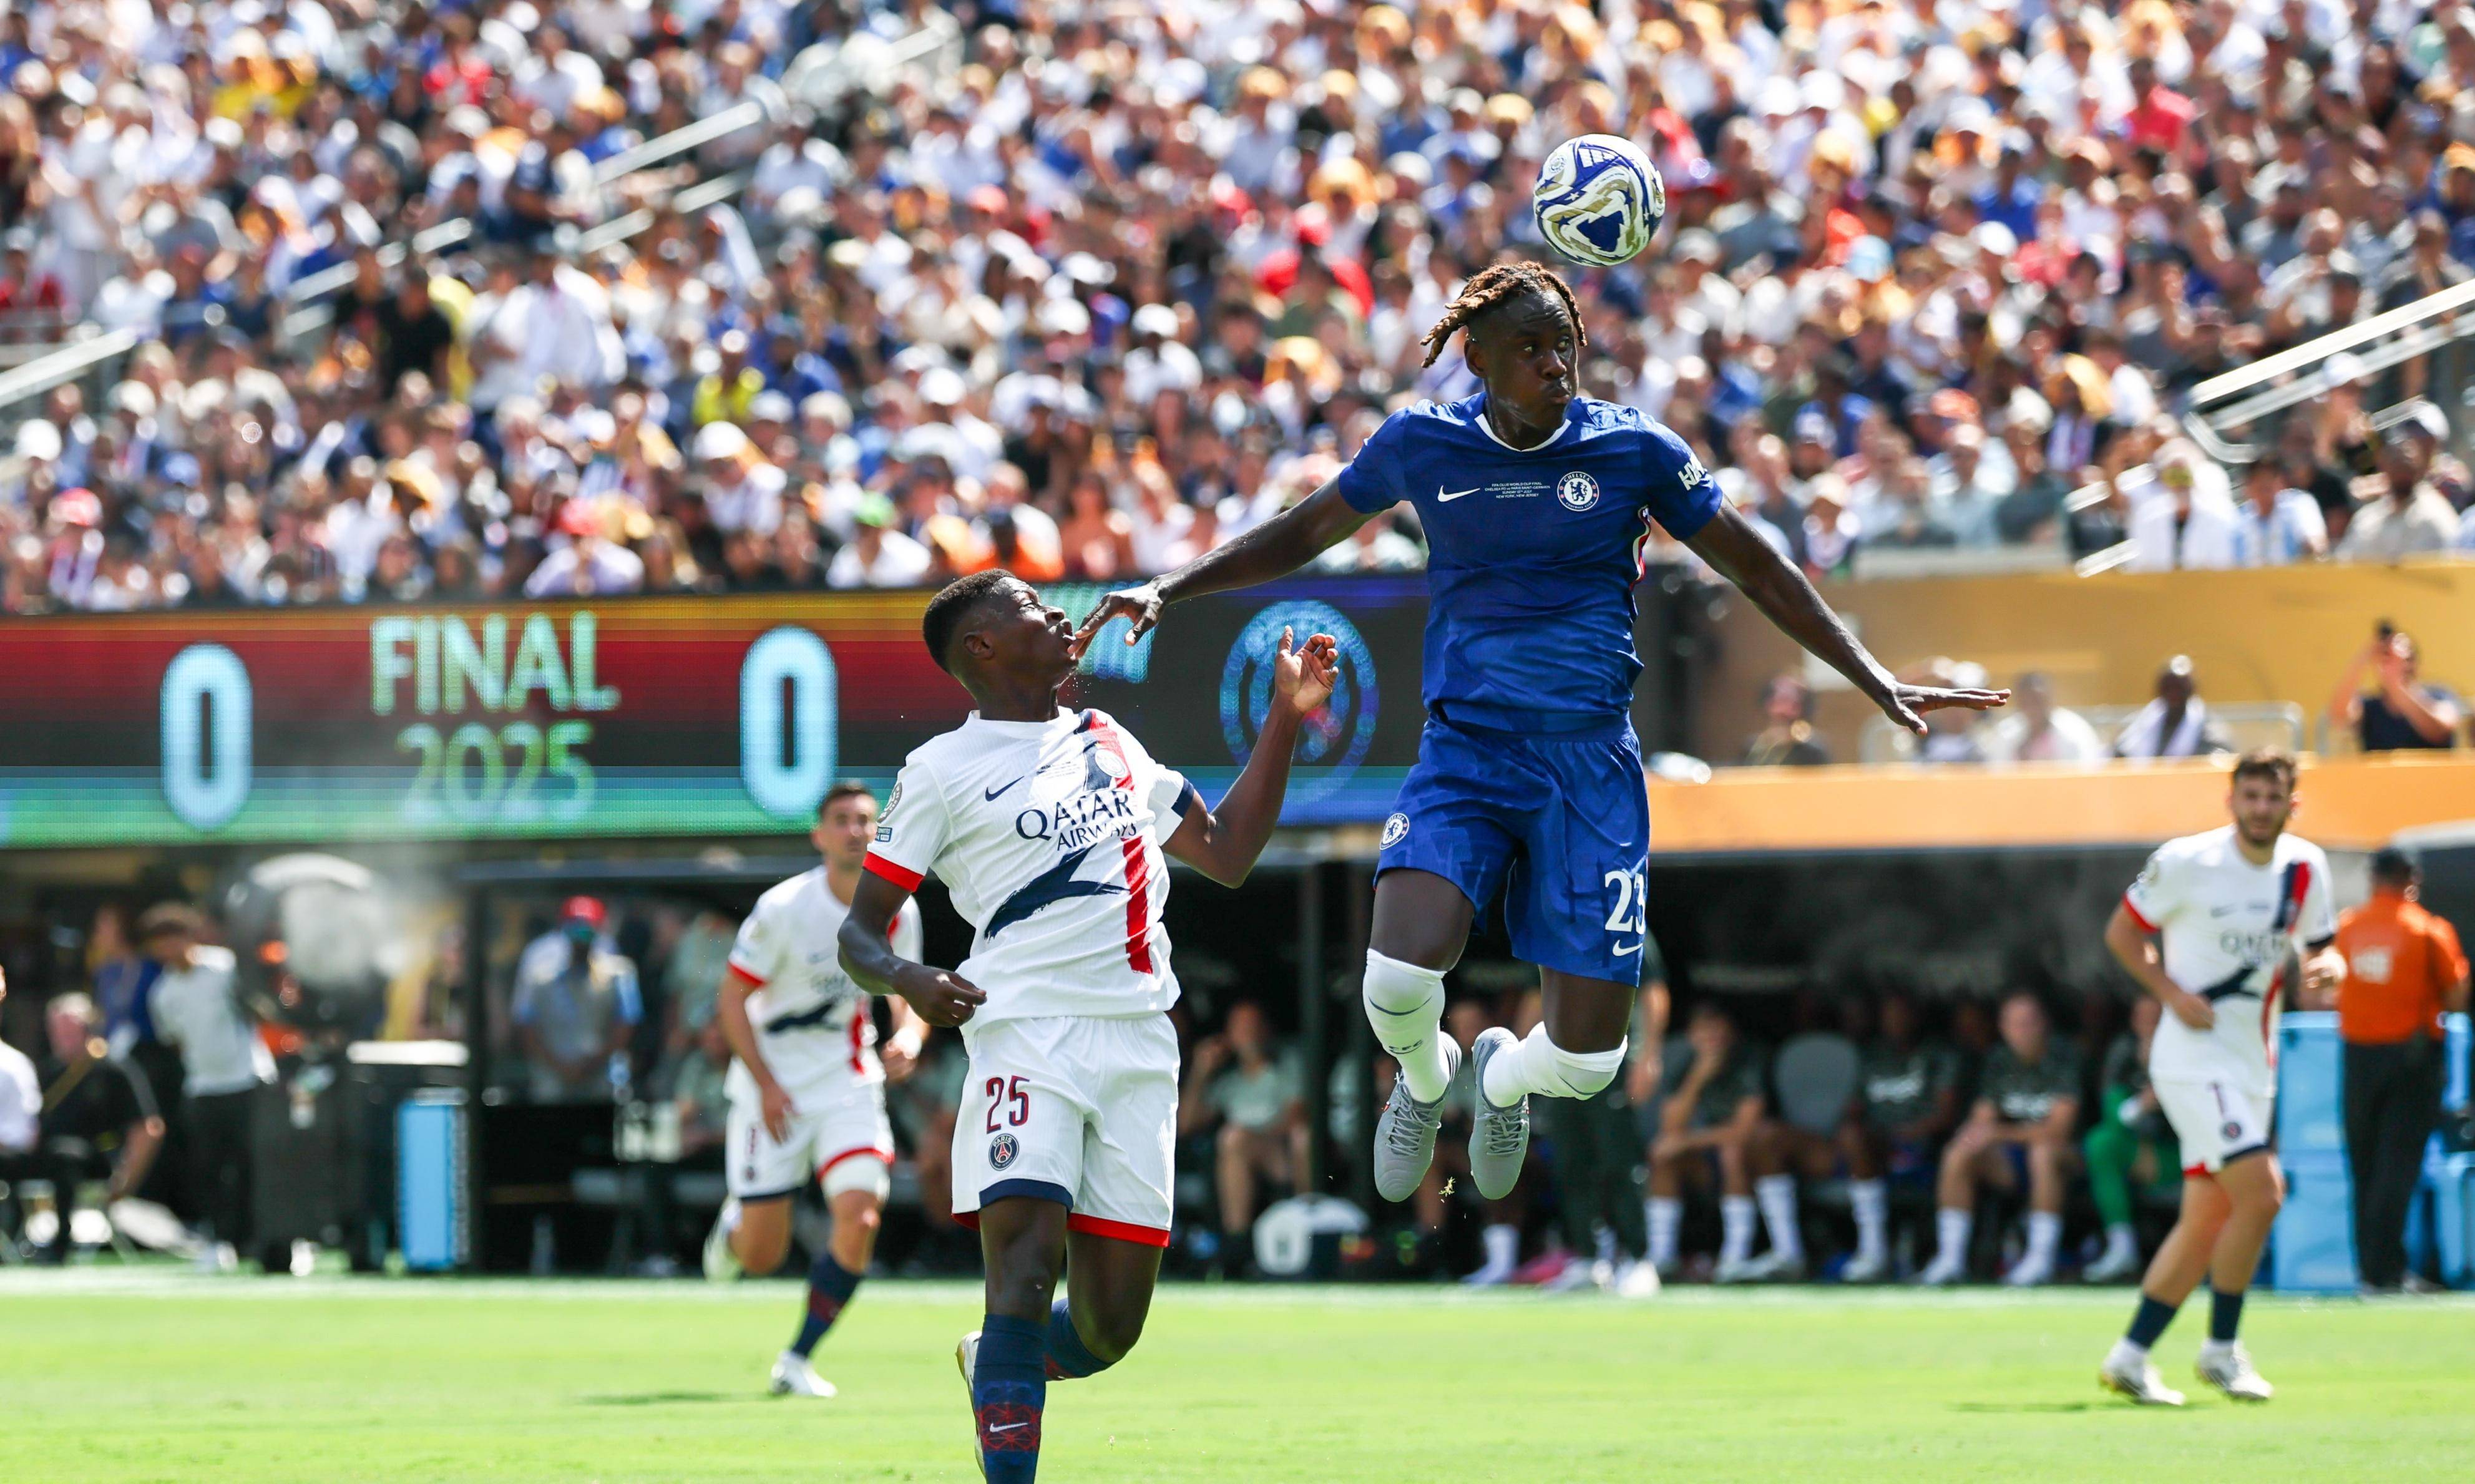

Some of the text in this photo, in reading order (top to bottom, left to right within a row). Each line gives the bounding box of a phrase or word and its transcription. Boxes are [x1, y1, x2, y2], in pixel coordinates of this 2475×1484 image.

[1564, 473, 1590, 482] CHELSEA
[371, 610, 622, 716] FINAL
[160, 641, 254, 831] 0
[740, 624, 839, 819] 0
[397, 720, 595, 825] 2025
[1015, 790, 1134, 841] QATAR
[1057, 823, 1136, 851] AIRWAYS
[1604, 871, 1646, 935] 23
[986, 1075, 1030, 1135] 25
[993, 1136, 1012, 1147] PARIS
